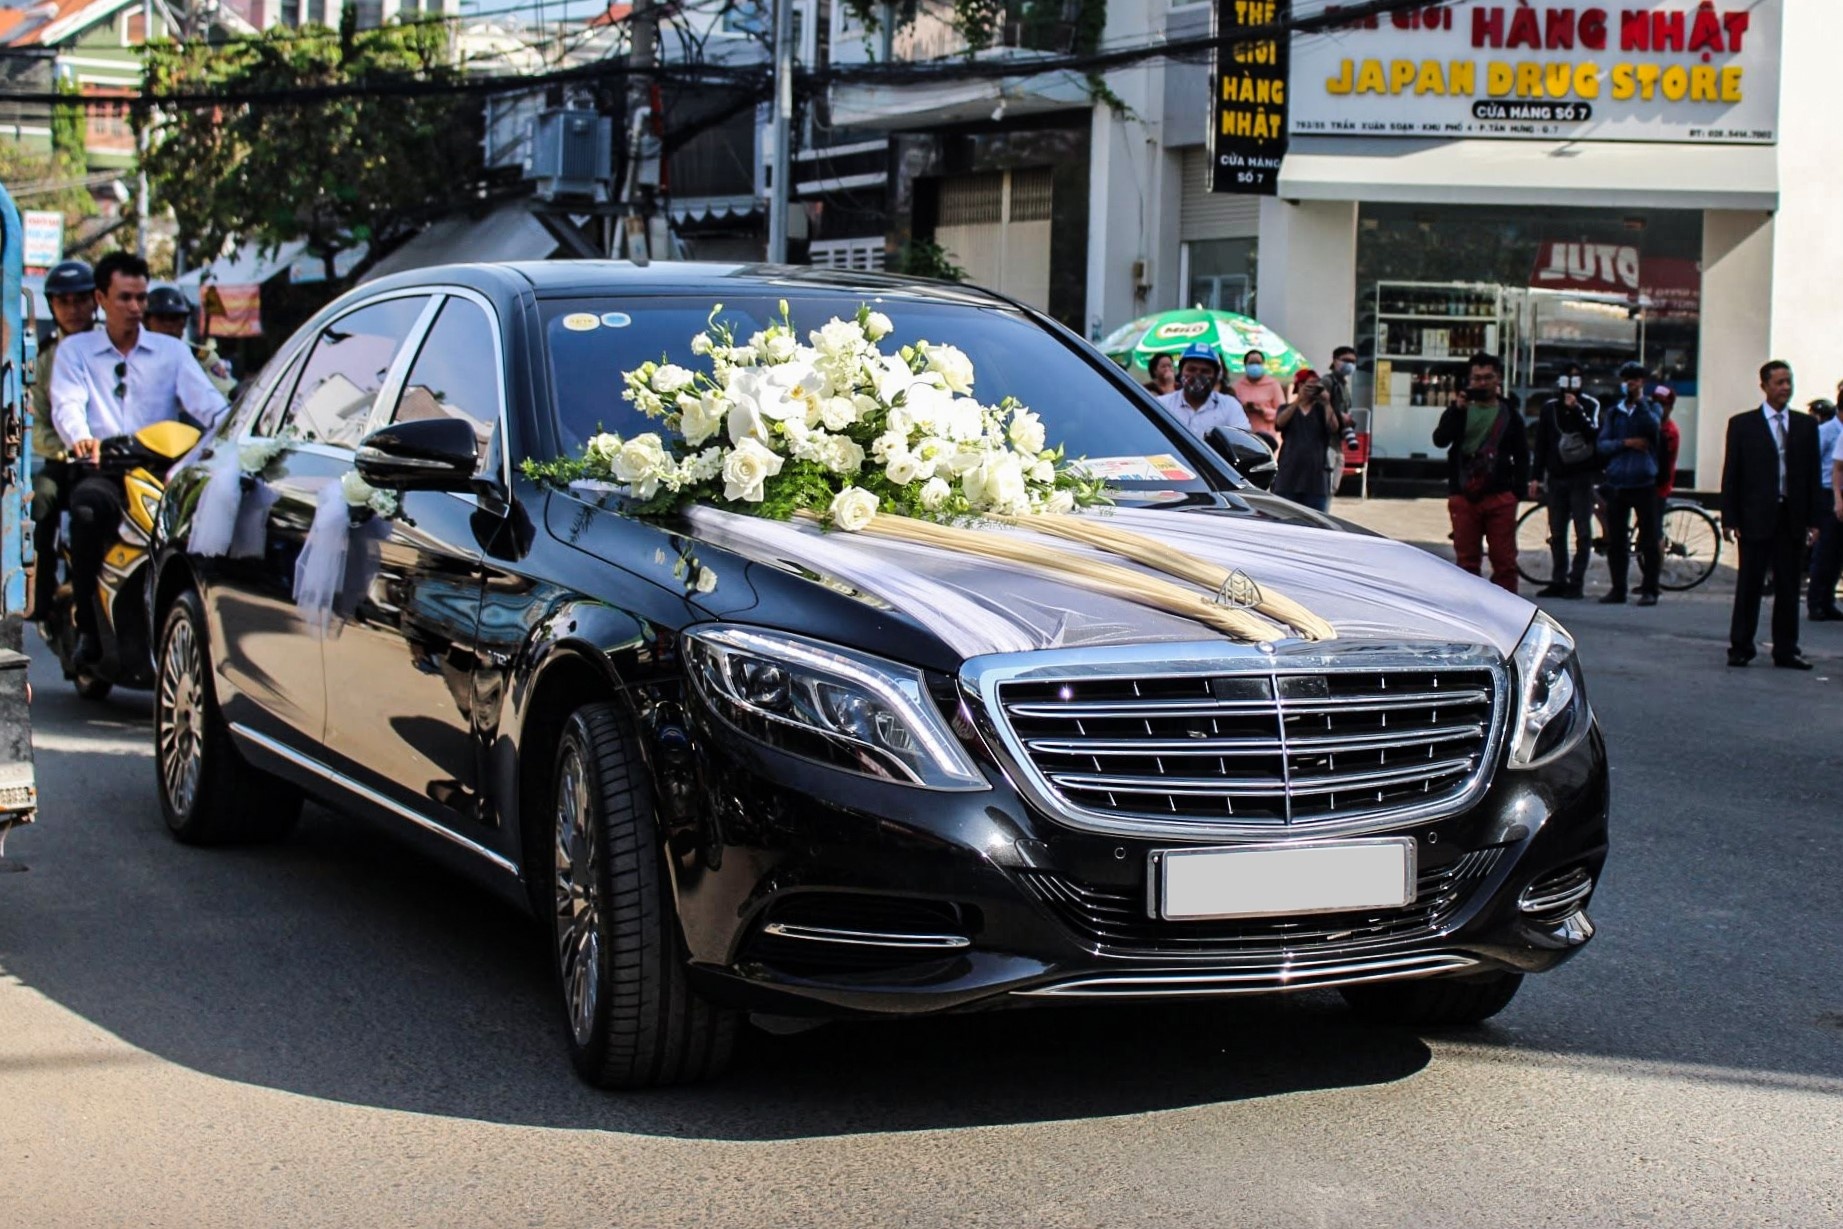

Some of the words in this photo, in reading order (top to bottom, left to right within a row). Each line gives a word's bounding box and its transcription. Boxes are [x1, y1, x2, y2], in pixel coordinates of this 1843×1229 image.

[1471, 0, 1607, 50] HÀNG
[1620, 0, 1749, 62] NHẬT
[1222, 70, 1284, 104] HÀNG
[1326, 58, 1475, 96] JAPAN
[1487, 61, 1600, 99] DRUG
[1611, 63, 1743, 102] STORE
[1222, 106, 1281, 145] NHẬT
[1555, 104, 1575, 119] SỐ
[1579, 108, 1588, 119] 7
[1257, 173, 1264, 183] 7
